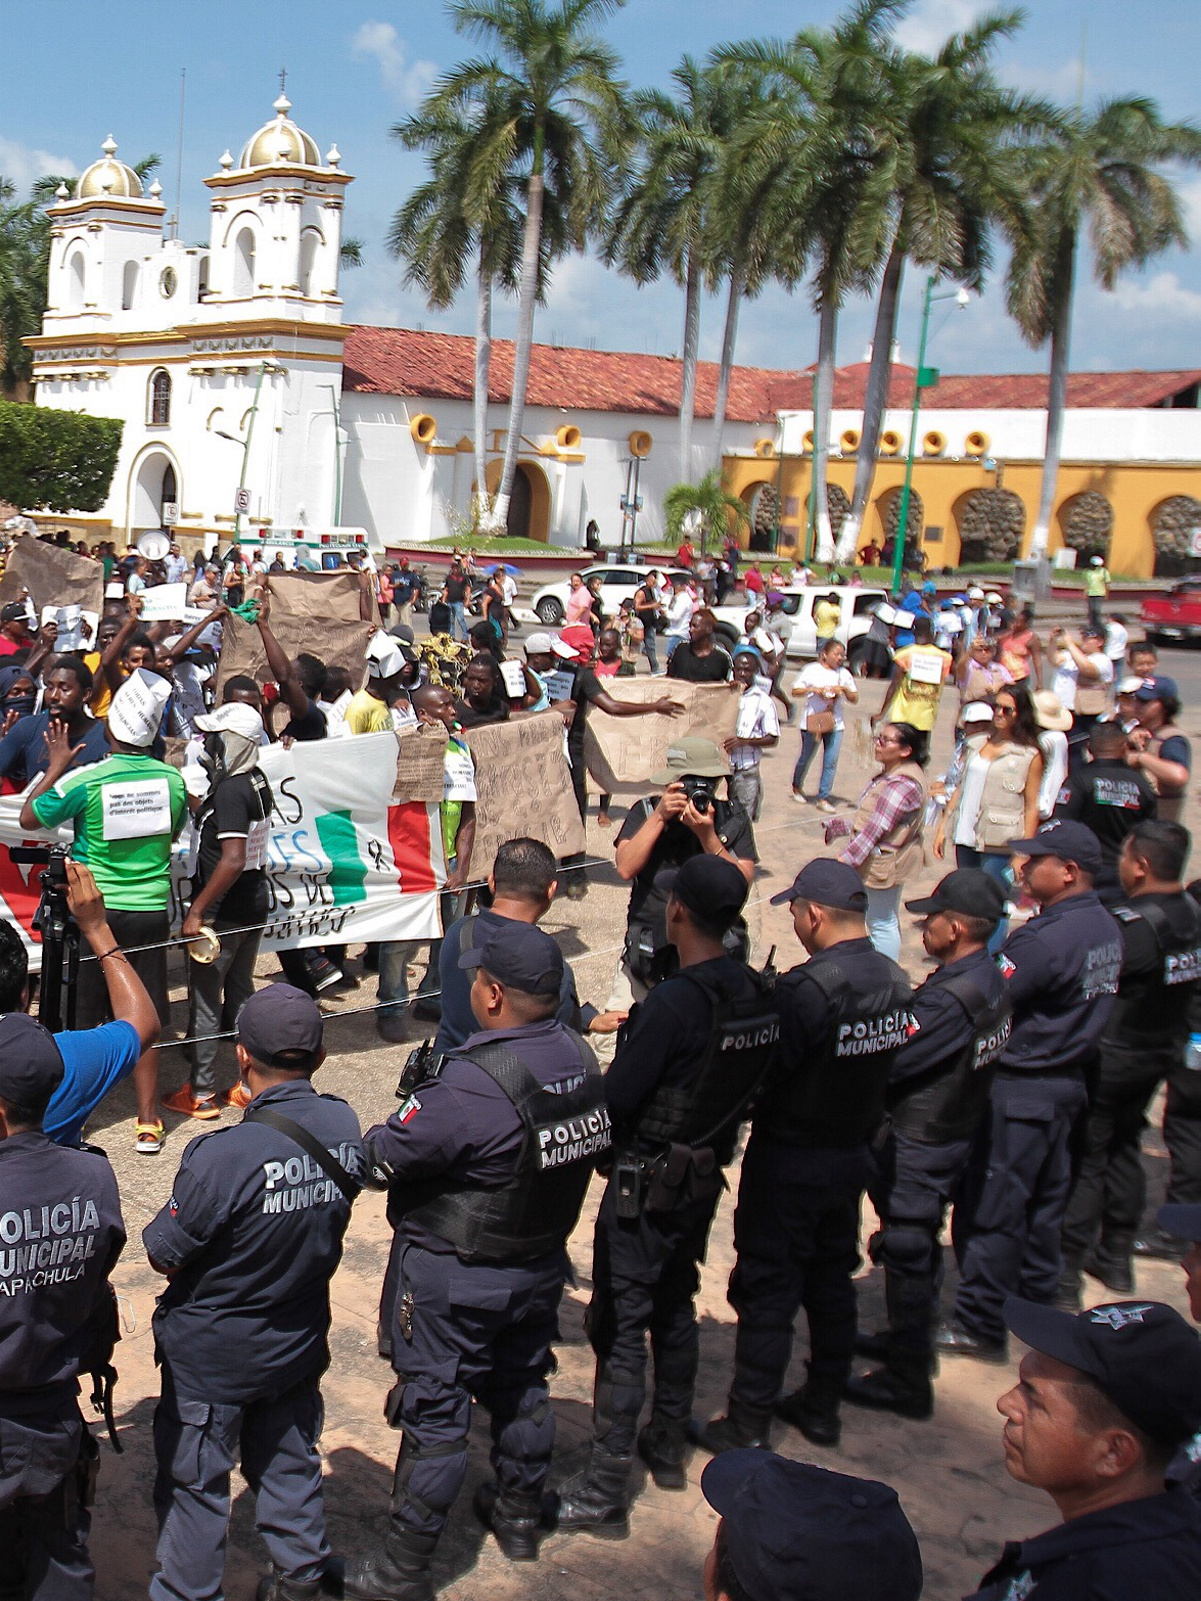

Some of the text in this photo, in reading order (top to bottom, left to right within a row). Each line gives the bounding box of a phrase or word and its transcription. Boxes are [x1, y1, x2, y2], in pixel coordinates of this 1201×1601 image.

[722, 1024, 780, 1051] POLICÍA
[839, 1010, 909, 1041] POLICÍA
[837, 1029, 909, 1057] MUNICIPAL
[539, 1106, 612, 1149] POLICÍA
[541, 1129, 613, 1169] MUNICIPAL
